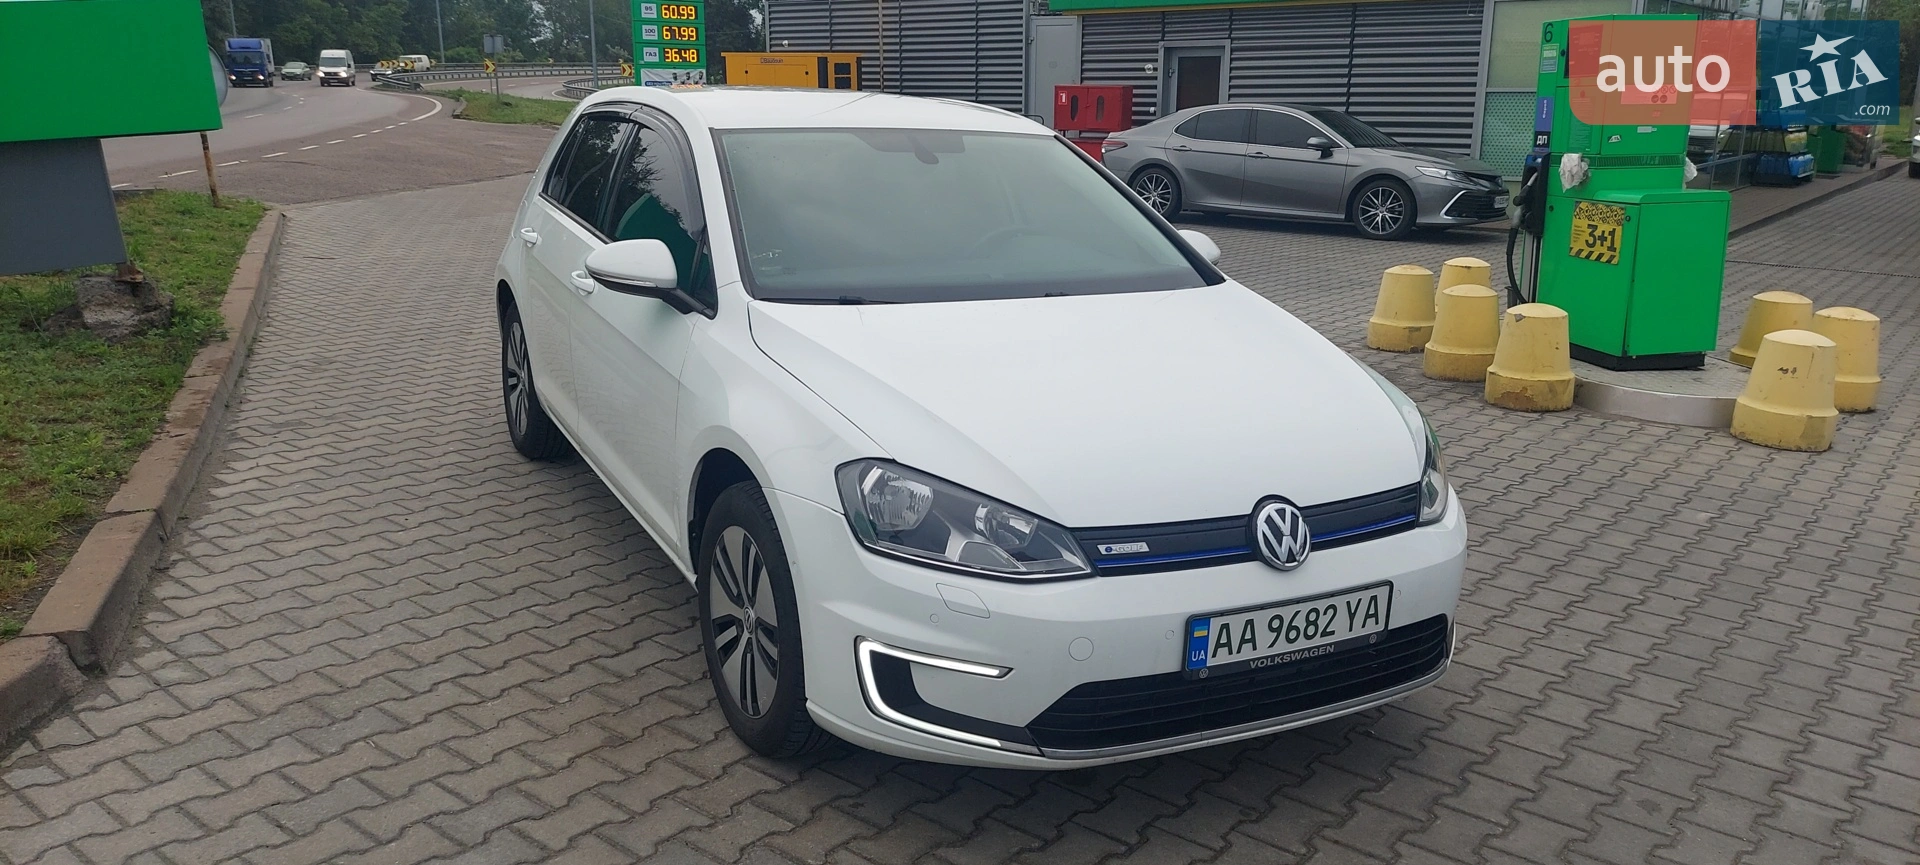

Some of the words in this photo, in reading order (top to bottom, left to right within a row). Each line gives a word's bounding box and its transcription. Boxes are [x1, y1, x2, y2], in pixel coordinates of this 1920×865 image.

[661, 5, 696, 19] 60.99
[662, 26, 697, 41] 67.99
[1544, 22, 1554, 43] 6
[664, 48, 698, 63] 36.48
[1536, 135, 1548, 146] ДП
[1584, 223, 1618, 253] 3+1
[1211, 618, 1258, 659] AA
[1267, 603, 1338, 649] 9682
[1345, 594, 1380, 633] YA
[1191, 649, 1206, 662] UA
[1250, 644, 1335, 669] VOLKSWAGEN
